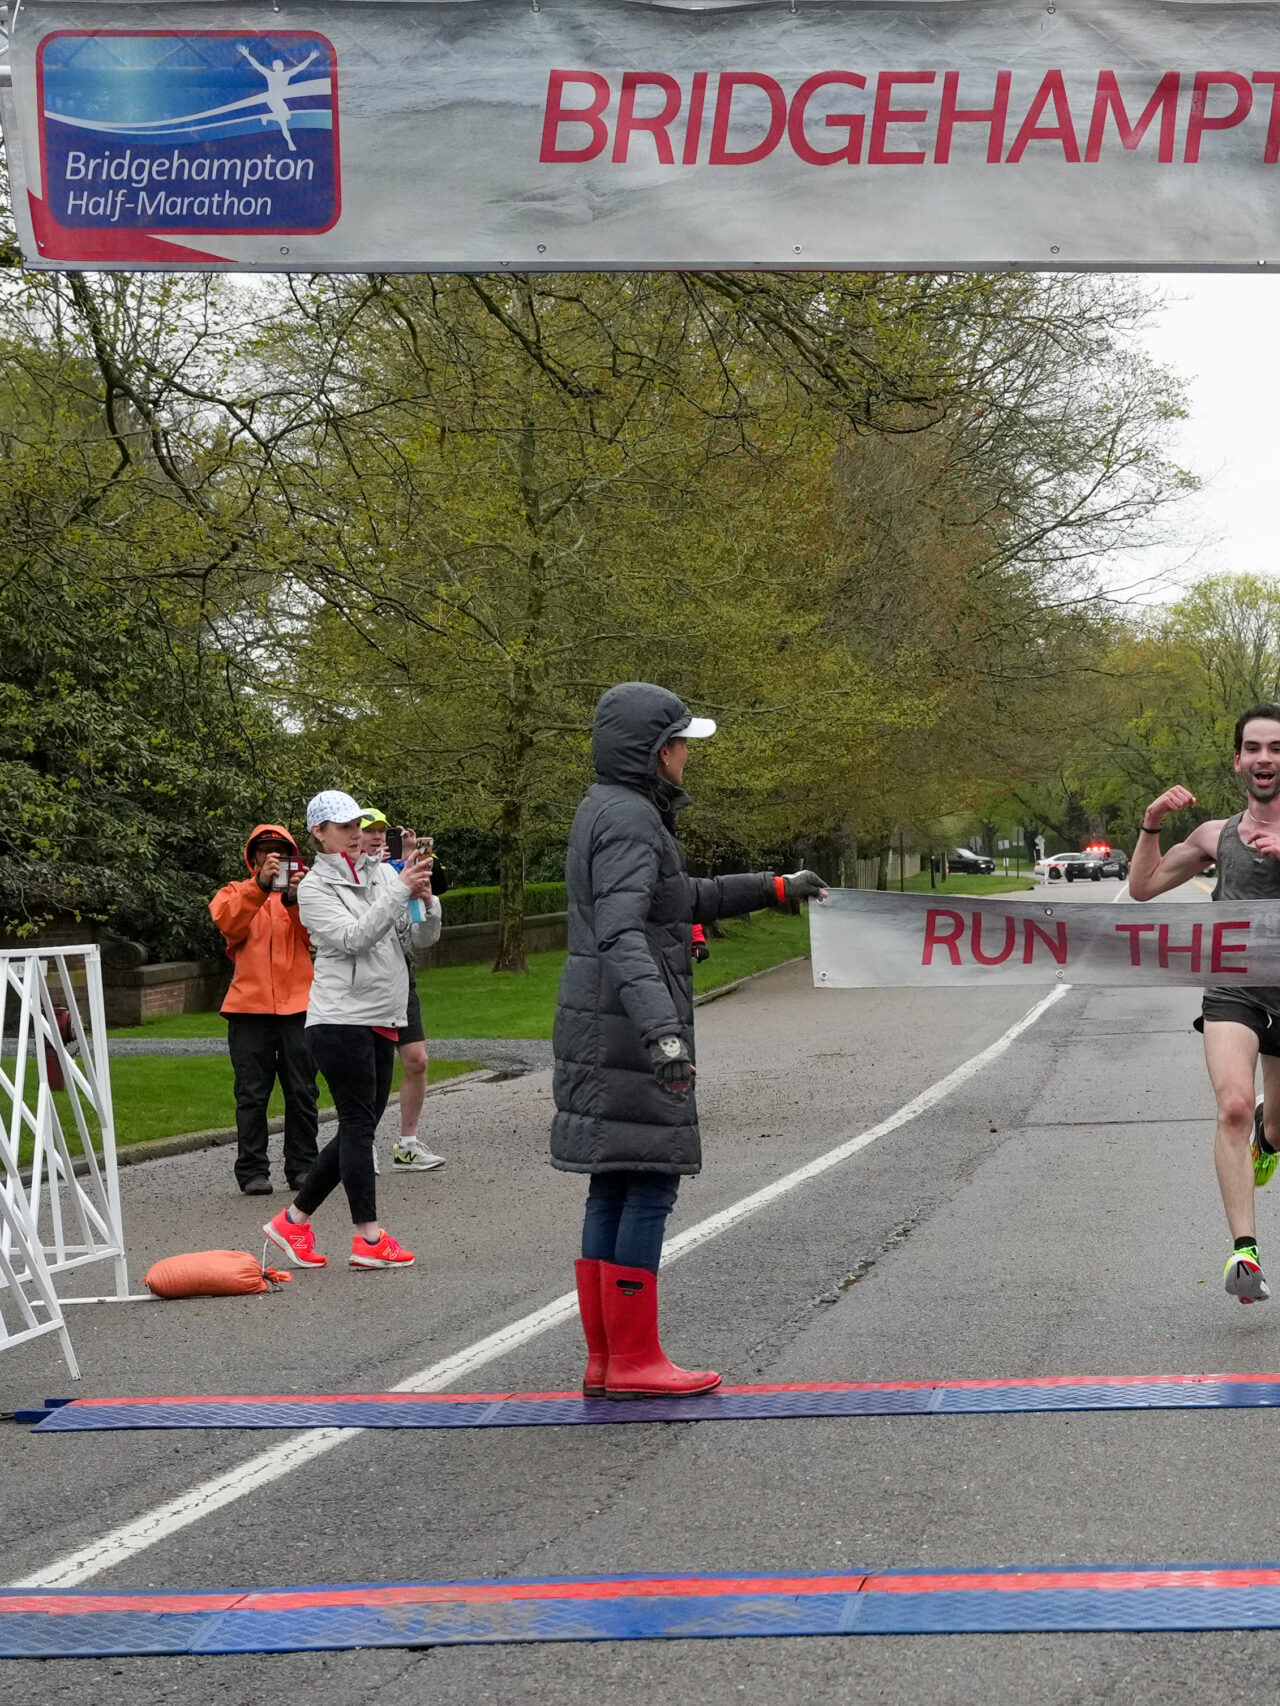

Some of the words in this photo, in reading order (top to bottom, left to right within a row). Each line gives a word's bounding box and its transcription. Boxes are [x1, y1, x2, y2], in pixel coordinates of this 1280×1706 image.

[65, 150, 314, 188] Bridgehampton
[66, 189, 272, 222] Half-Marathon
[921, 909, 1068, 966] RUN
[1115, 921, 1252, 974] THE
